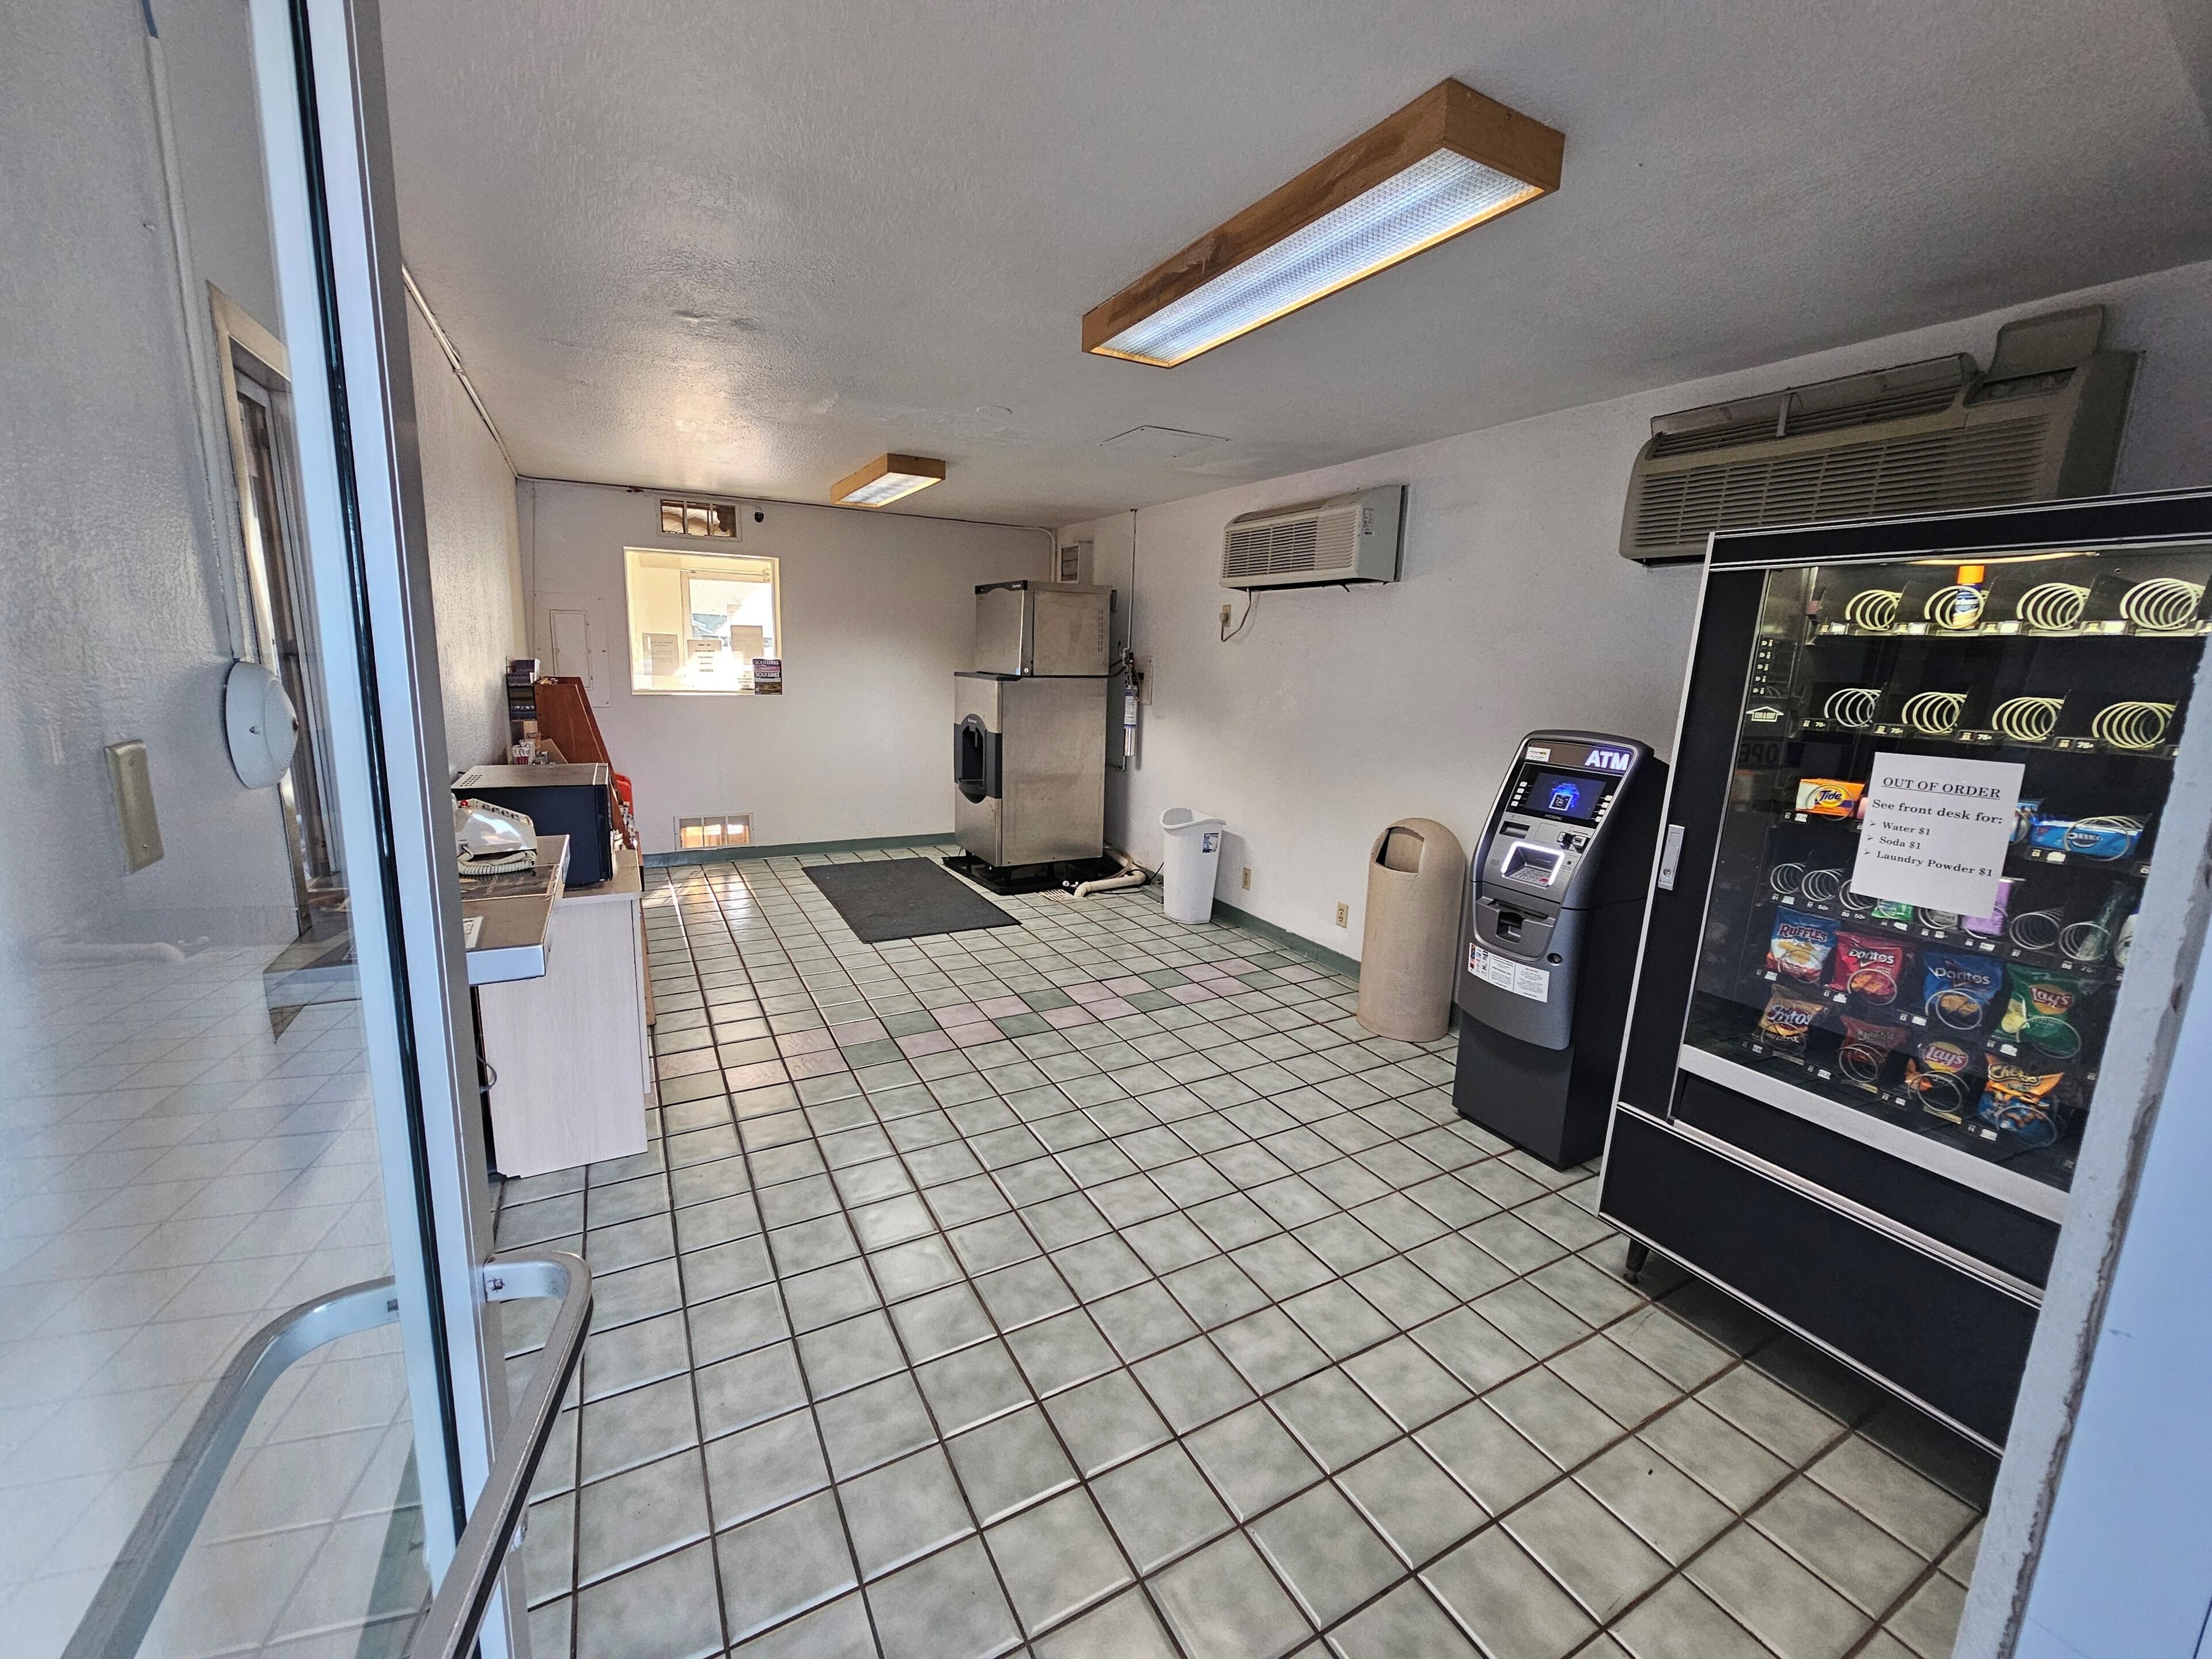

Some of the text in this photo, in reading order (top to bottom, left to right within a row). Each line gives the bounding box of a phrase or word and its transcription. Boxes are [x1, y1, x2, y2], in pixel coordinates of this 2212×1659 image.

[1585, 750, 1630, 771] ATM
[1819, 790, 1842, 801] Tide
[1883, 778, 2001, 798] OUT OF ORDER
[1872, 799, 2003, 824] See front desk for:
[1883, 821, 1930, 835] Water $1
[1879, 836, 1921, 850] Soda $1
[2067, 832, 2104, 841] OREO
[1877, 851, 1993, 877] Laundry Powder $1
[1778, 923, 1828, 942] RUFFLES
[1849, 949, 1895, 964] Doritos
[1935, 968, 1991, 984] Doritos
